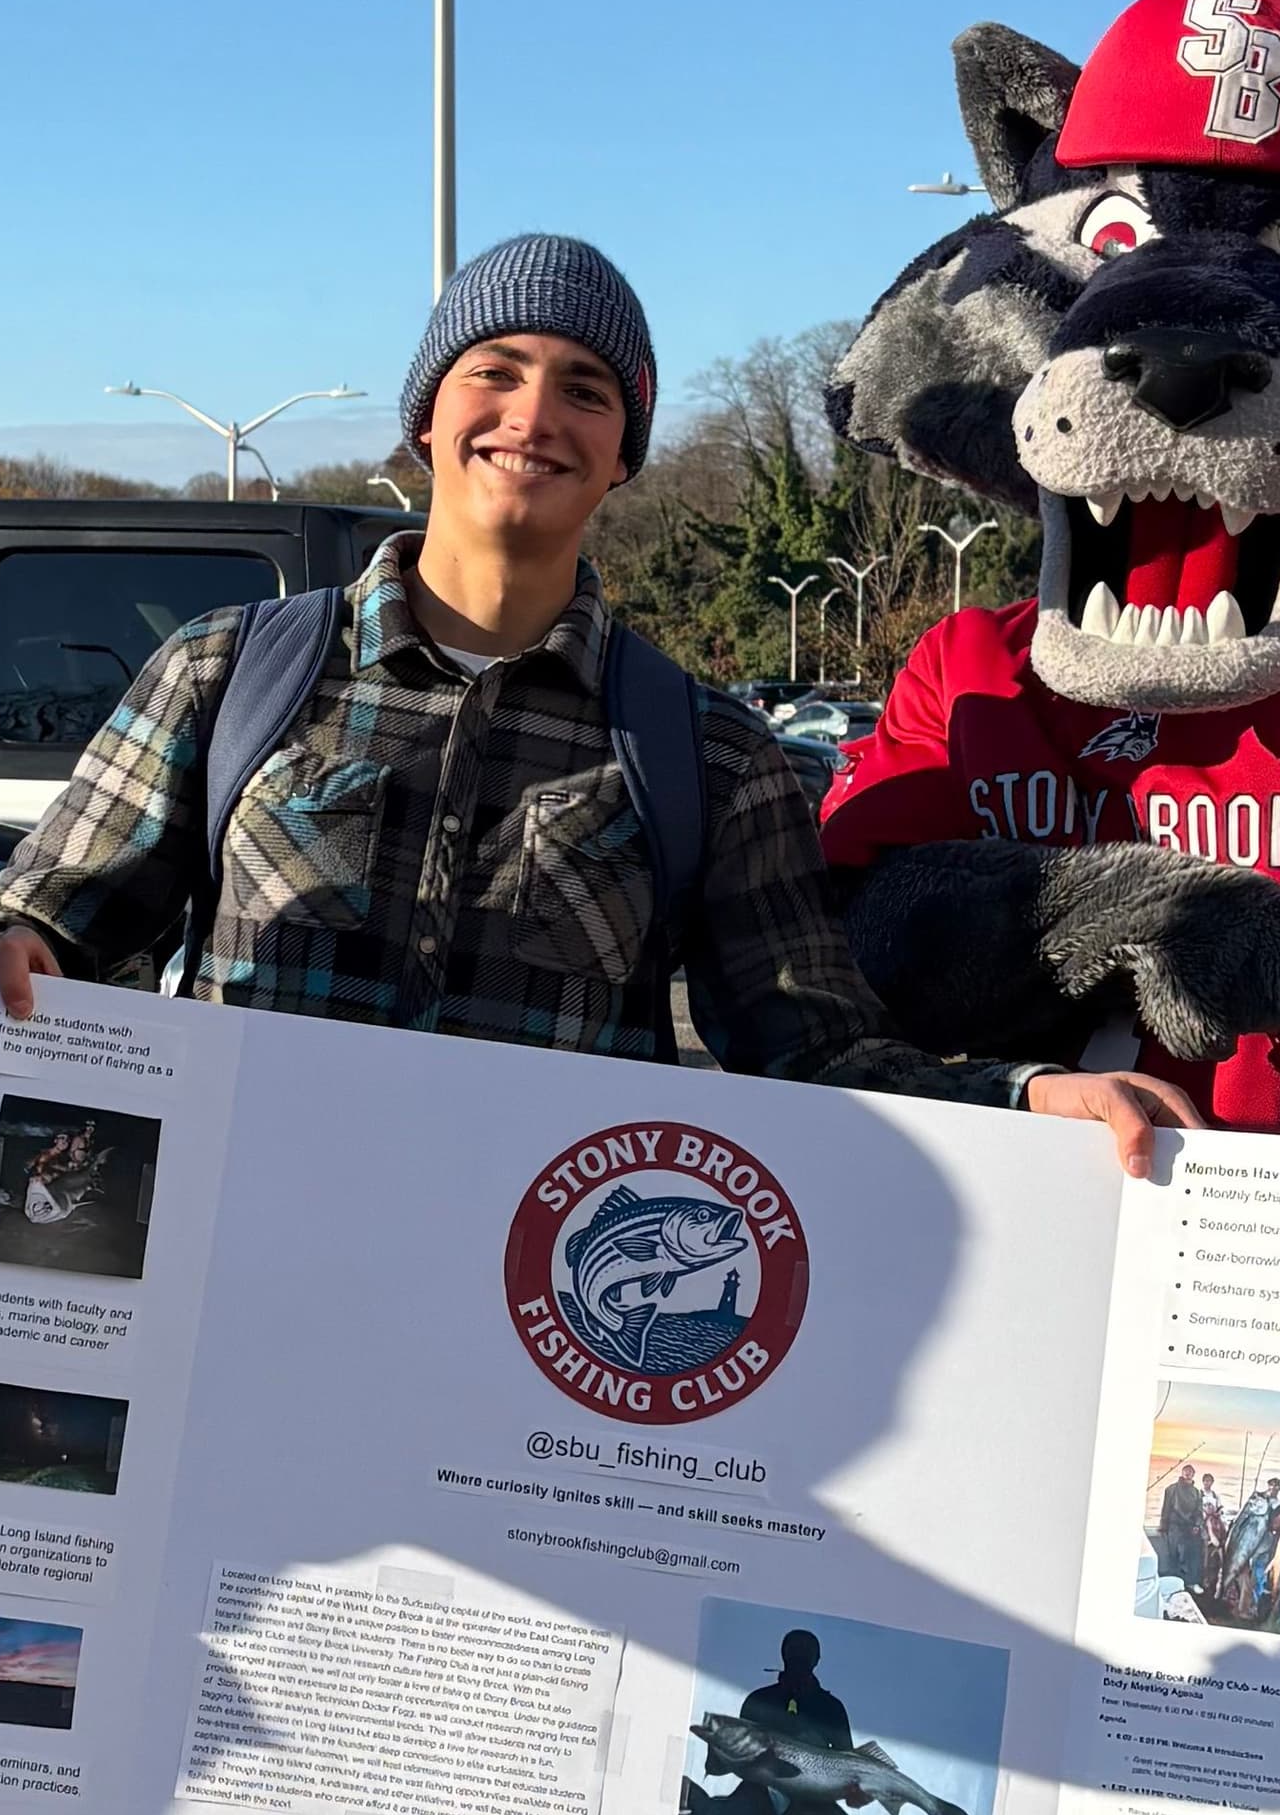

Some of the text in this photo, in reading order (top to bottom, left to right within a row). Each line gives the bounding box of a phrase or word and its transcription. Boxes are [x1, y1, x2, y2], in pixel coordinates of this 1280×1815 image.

[54, 1017, 105, 1034] students
[108, 1026, 133, 1038] with
[1184, 1161, 1248, 1178] Members
[537, 1129, 797, 1251] STONY BROOK
[1202, 1186, 1250, 1204] Monthly
[1199, 1217, 1257, 1233] Seasonal
[38, 1299, 63, 1311] with
[66, 1300, 107, 1319] faculty
[109, 1309, 133, 1320] and
[1188, 1312, 1247, 1328] Seminars
[7, 1311, 51, 1326] marine
[53, 1315, 101, 1335] biology,
[103, 1324, 127, 1336] and
[42, 1332, 67, 1344] and
[69, 1336, 109, 1350] career
[1185, 1343, 1245, 1360] Research
[517, 1294, 770, 1412] FISHING CLUB
[526, 1431, 766, 1483] @sbu_fishing_club
[437, 1468, 826, 1541] Where curiosity ignites skill and skill seeks mastery
[0, 1524, 31, 1542] Long
[34, 1529, 72, 1546] Island
[74, 1534, 114, 1554] fishing
[9, 1545, 92, 1566] organizations
[95, 1555, 107, 1567] to
[507, 1528, 740, 1573] stonybrookfishingclub@gmail.com
[43, 1566, 93, 1583] regional
[56, 1766, 80, 1778] and
[21, 1778, 80, 1796] practices,
